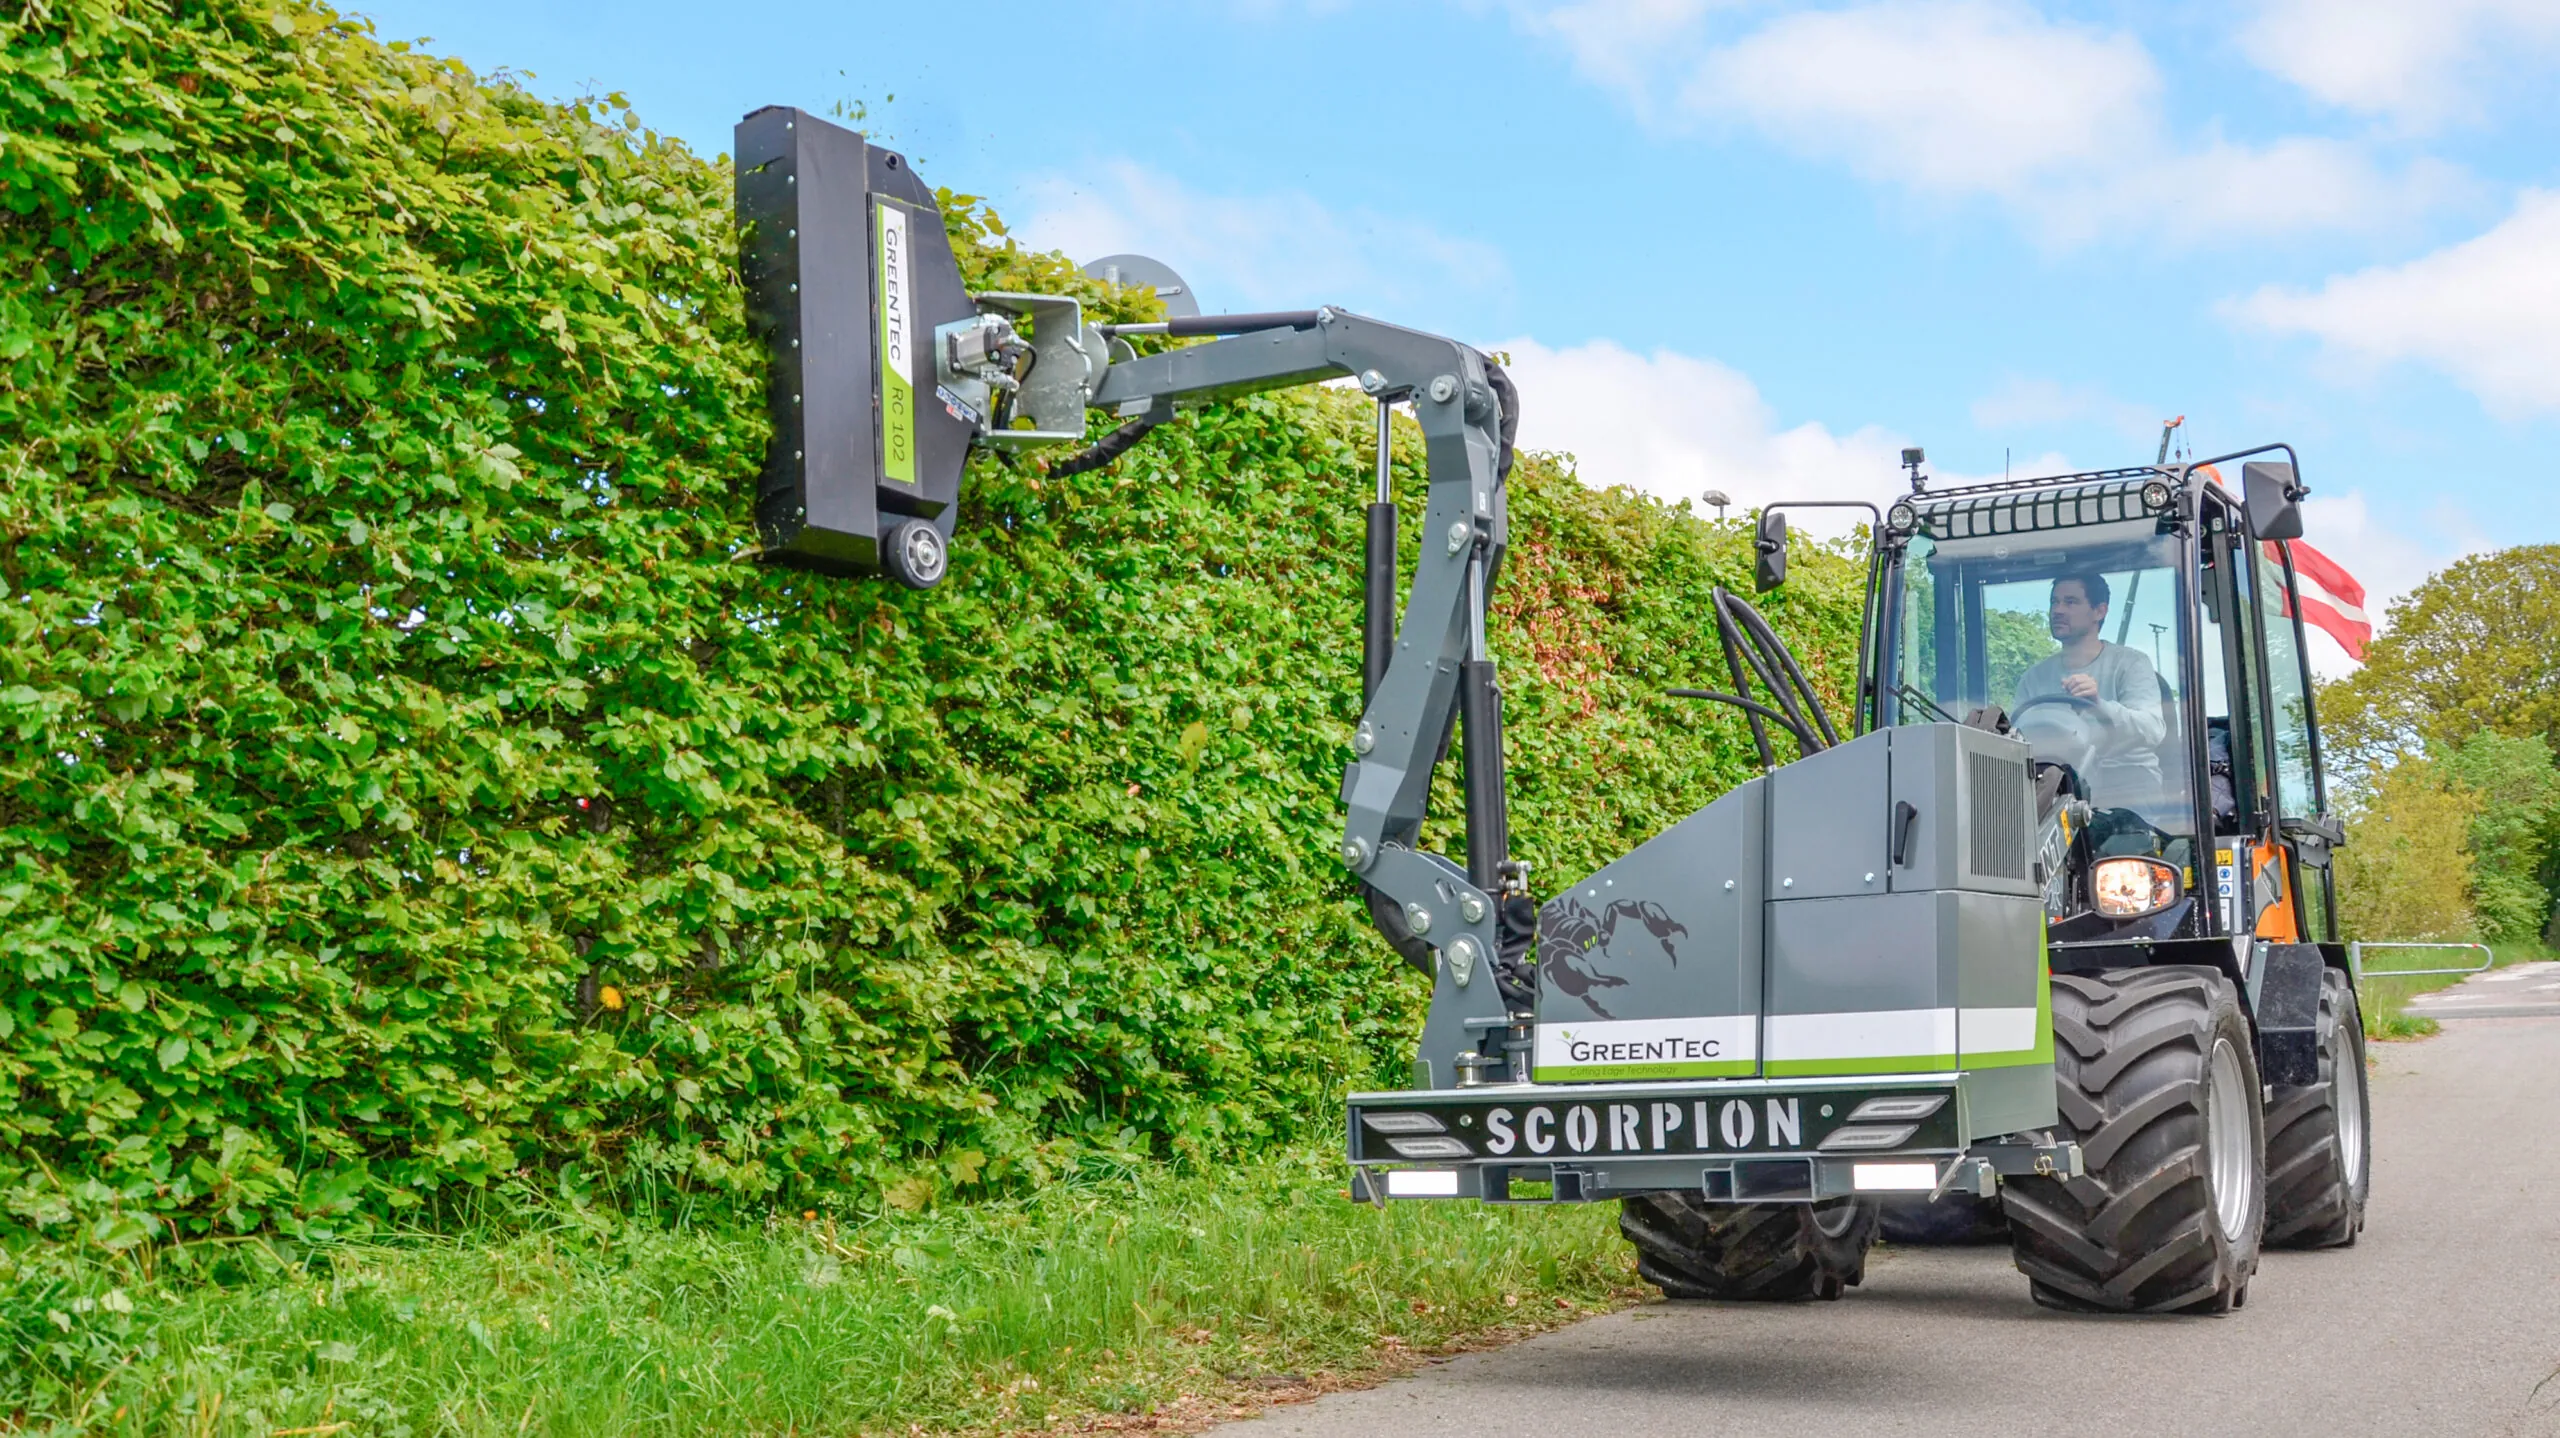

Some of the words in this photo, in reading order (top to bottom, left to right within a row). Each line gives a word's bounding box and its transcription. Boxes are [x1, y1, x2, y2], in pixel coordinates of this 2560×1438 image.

[891, 387, 904, 416] RC
[892, 422, 905, 462] 102
[1569, 1066, 1600, 1077] Cutting
[1602, 1066, 1625, 1077] Edge
[1627, 1064, 1678, 1076] Technology
[1485, 1097, 1801, 1156] SCORPION
